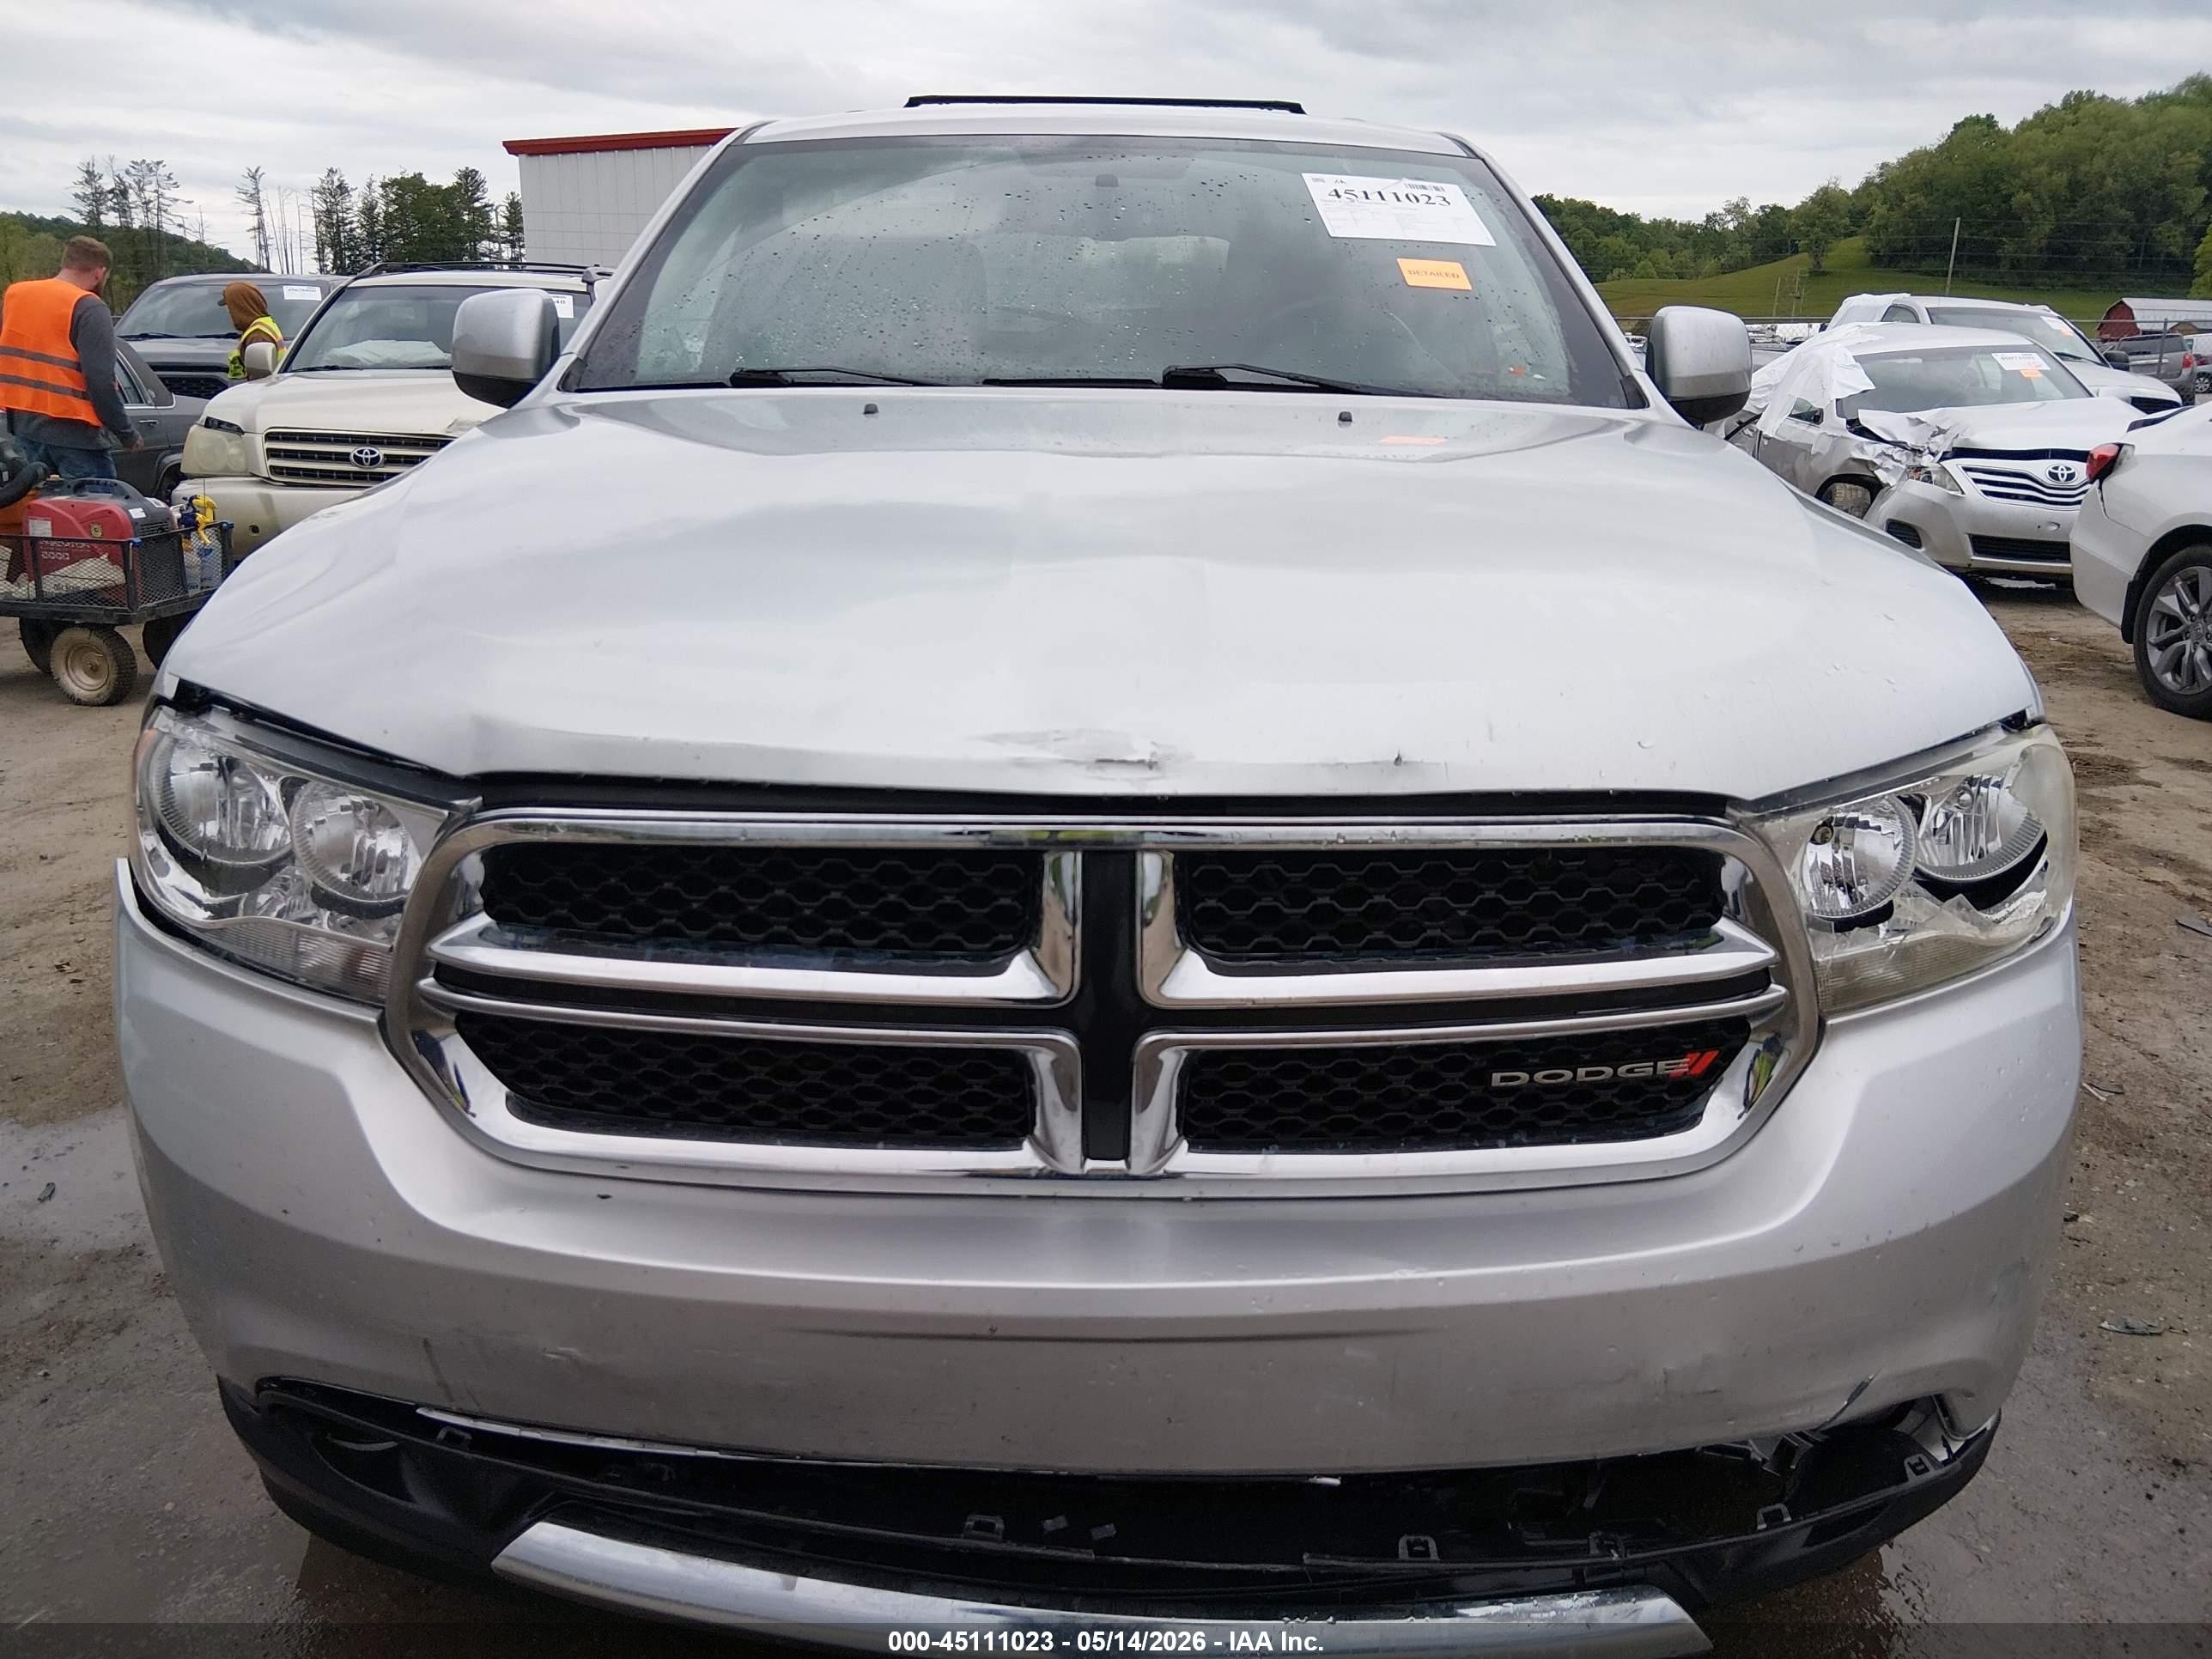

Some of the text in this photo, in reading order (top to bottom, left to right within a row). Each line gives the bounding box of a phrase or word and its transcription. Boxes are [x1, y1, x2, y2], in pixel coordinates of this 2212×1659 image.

[1327, 187, 1452, 206] 45111023
[1407, 269, 1460, 280] DETAILED
[1491, 1057, 1690, 1087] DODGE
